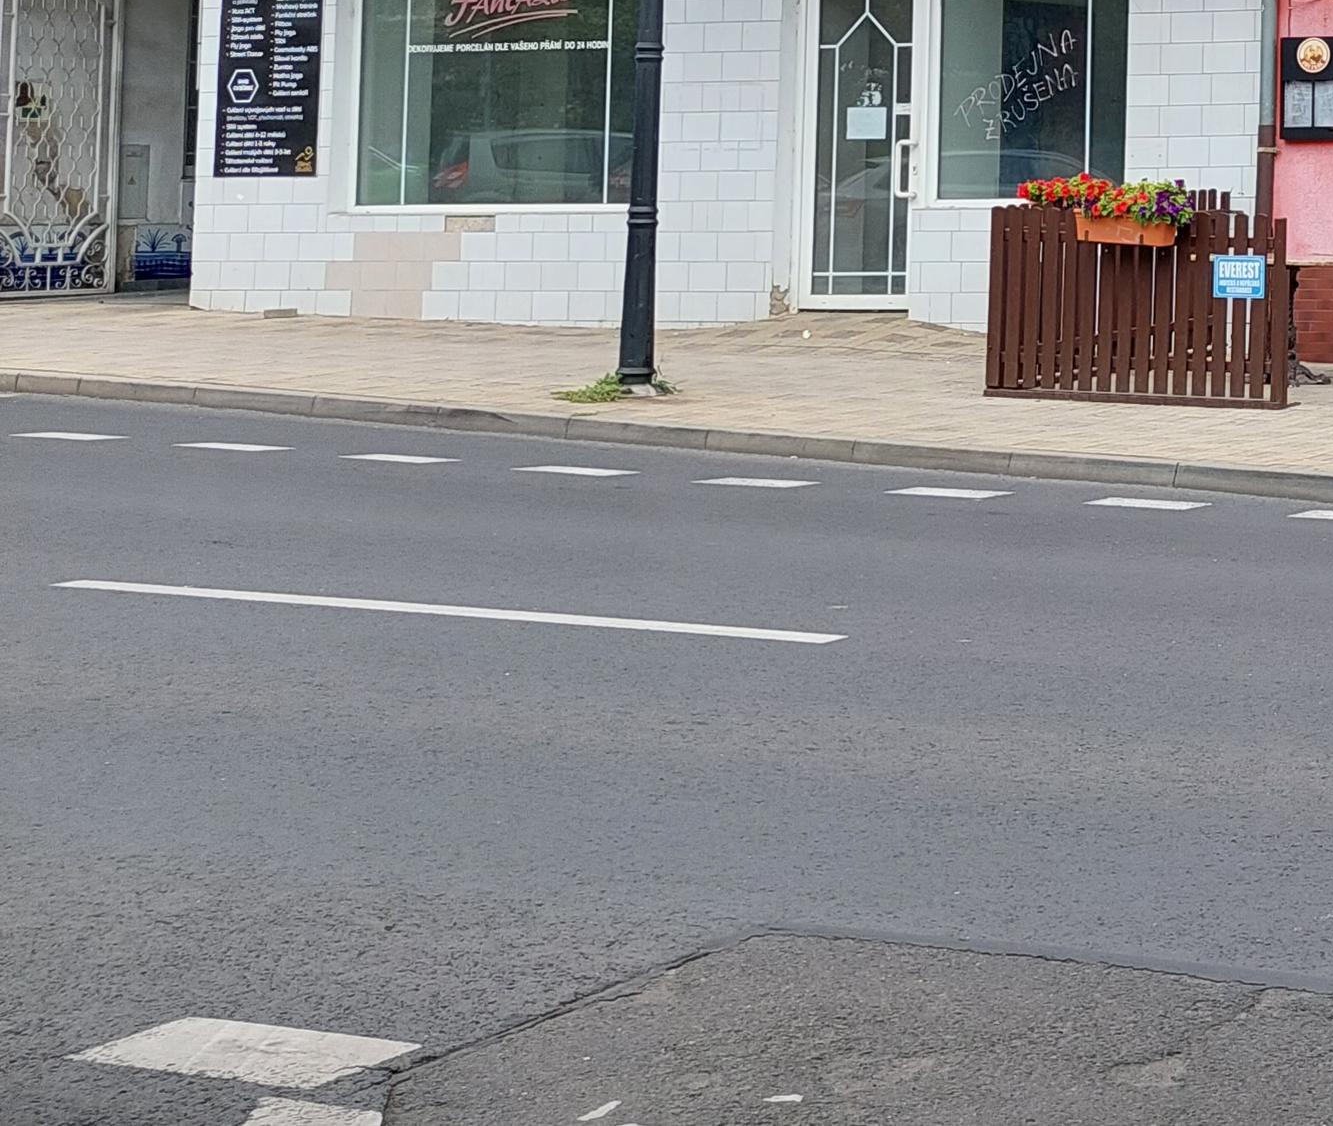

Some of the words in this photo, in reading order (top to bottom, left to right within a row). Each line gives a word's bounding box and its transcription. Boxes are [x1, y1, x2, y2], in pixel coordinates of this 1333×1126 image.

[564, 41, 575, 50] DO
[953, 29, 1078, 128] PRODEJNA
[982, 63, 1079, 140] ZRUŠENA
[1219, 261, 1260, 279] EVEREST
